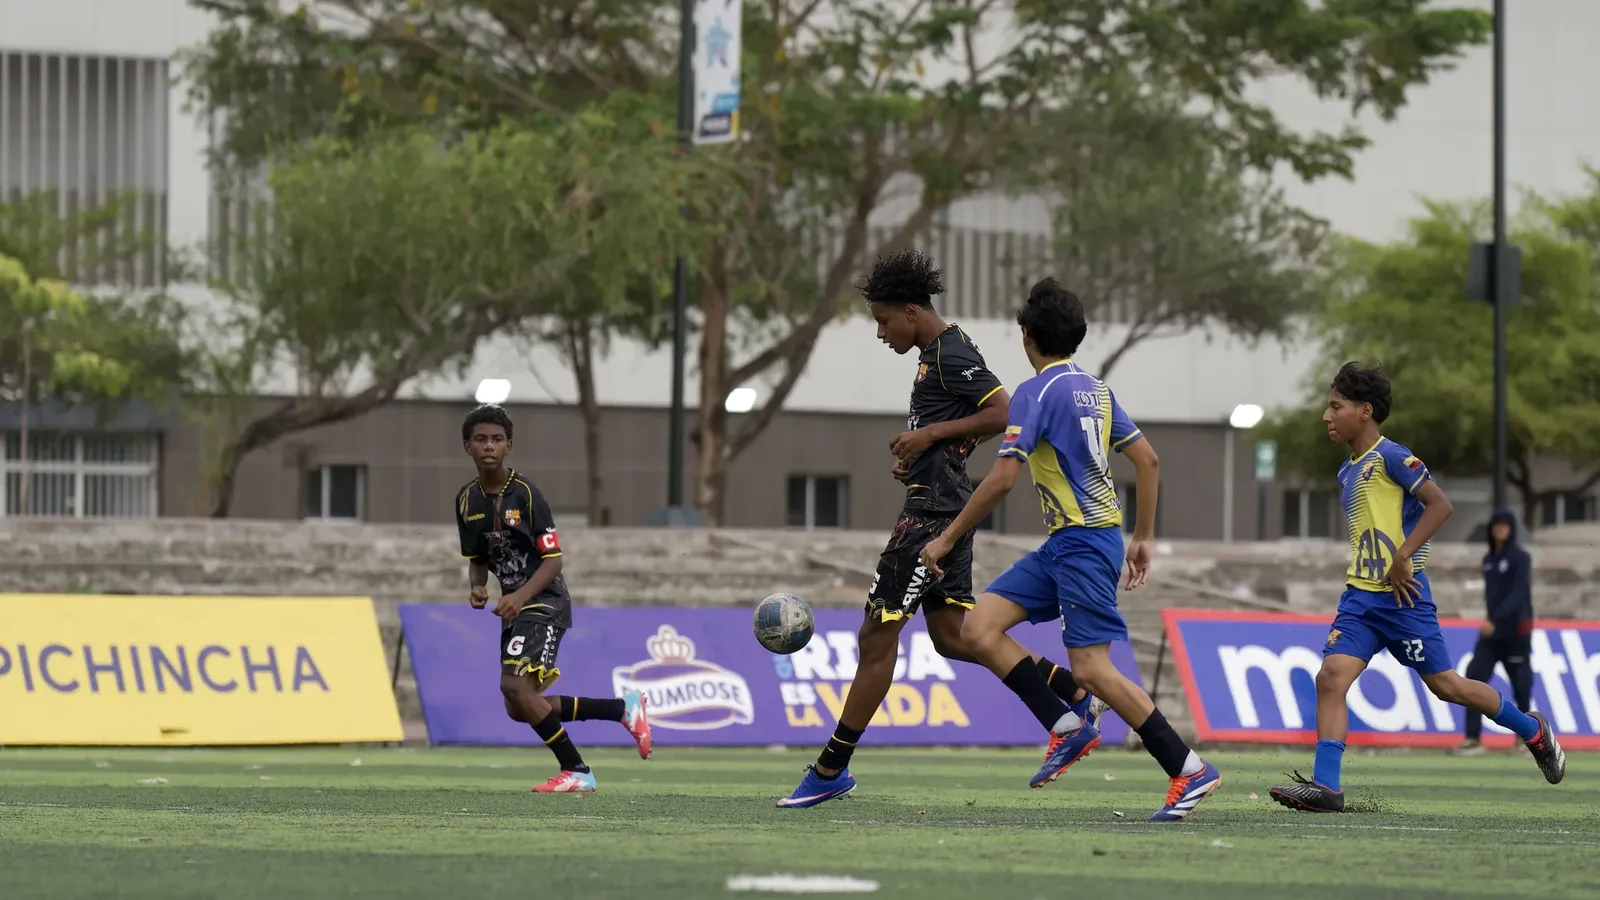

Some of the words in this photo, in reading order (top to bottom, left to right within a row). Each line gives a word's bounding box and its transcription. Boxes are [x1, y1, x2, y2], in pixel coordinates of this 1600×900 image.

[543, 533, 555, 549] C
[902, 557, 928, 606] RIVA
[507, 635, 525, 656] G
[1401, 639, 1425, 662] 22
[621, 680, 745, 707] UMROSE
[784, 704, 824, 727] LA
